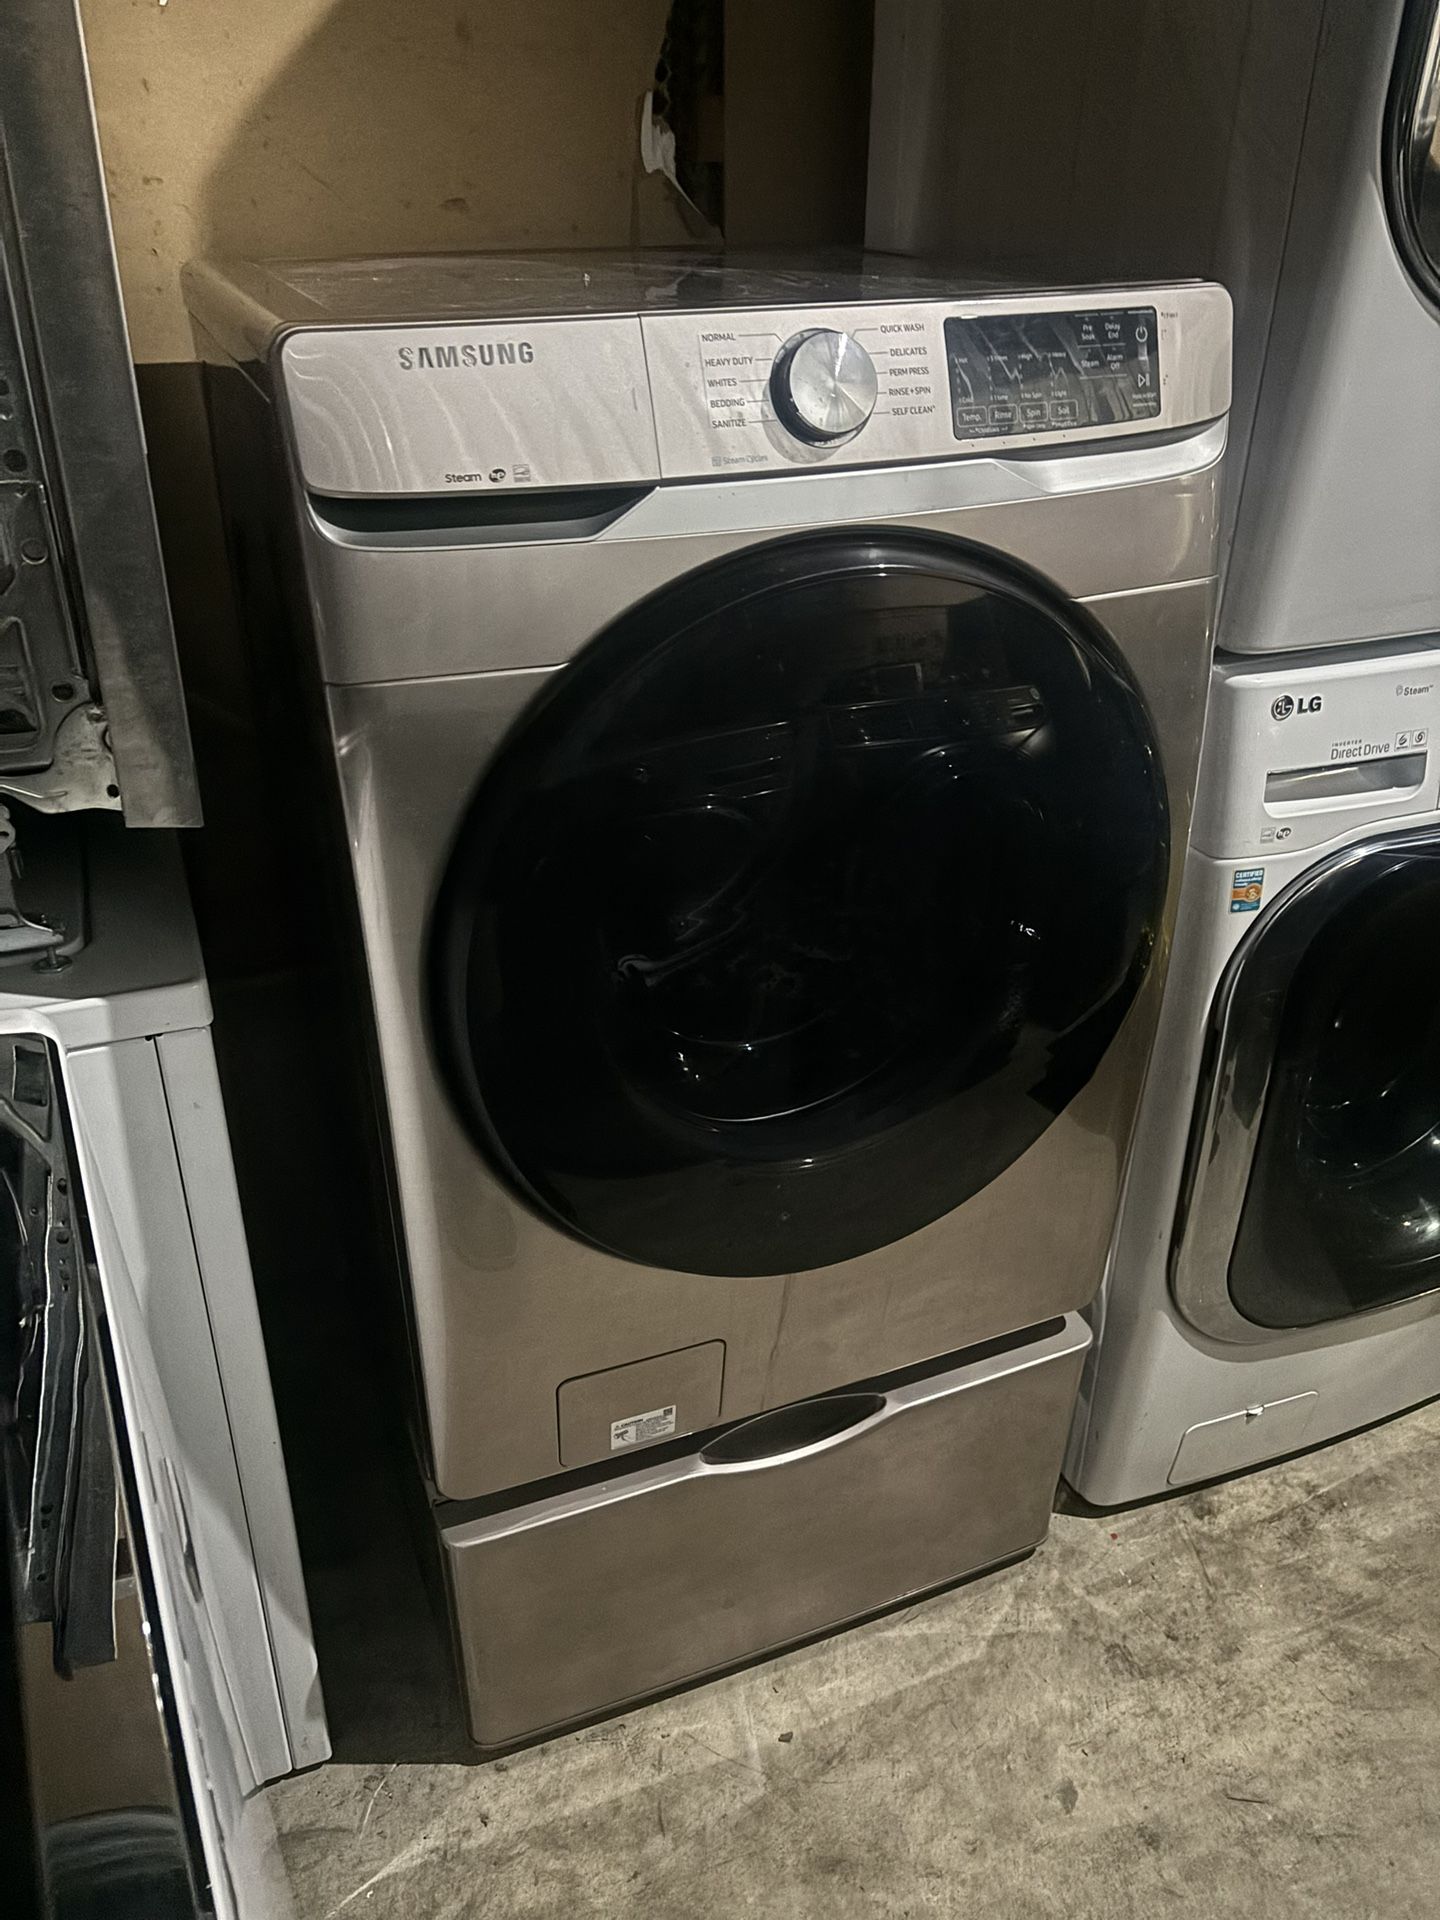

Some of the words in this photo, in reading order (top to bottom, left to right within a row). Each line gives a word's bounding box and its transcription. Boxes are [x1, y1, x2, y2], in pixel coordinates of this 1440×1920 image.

[880, 325, 902, 334] QUICK
[903, 323, 926, 332] WASH
[1082, 324, 1093, 332] Pre
[701, 333, 737, 342] NORMAL
[1108, 332, 1119, 340] End
[398, 342, 534, 370] SAMSUNG
[889, 347, 928, 357] DELICATES
[705, 359, 732, 368] HEAVY
[732, 357, 753, 365] DUTY
[1106, 354, 1124, 362] Alarm
[1080, 360, 1100, 369] Steam
[889, 368, 908, 377] PERM
[908, 366, 930, 376] PRESS
[707, 378, 738, 388] WHITES
[888, 388, 909, 397] RINSE
[914, 386, 931, 396] SPIN
[710, 398, 746, 408] BEDDING
[891, 406, 908, 416] SELF
[994, 410, 1012, 419] Rinse
[1026, 408, 1041, 419] Spin
[1057, 406, 1071, 416] Soil
[712, 419, 747, 429] SANITIZE
[445, 473, 482, 484] Steam
[1297, 696, 1322, 714] LG
[1332, 739, 1362, 747] INVERTER
[1331, 747, 1362, 760] Direct
[1363, 743, 1390, 756] Drive
